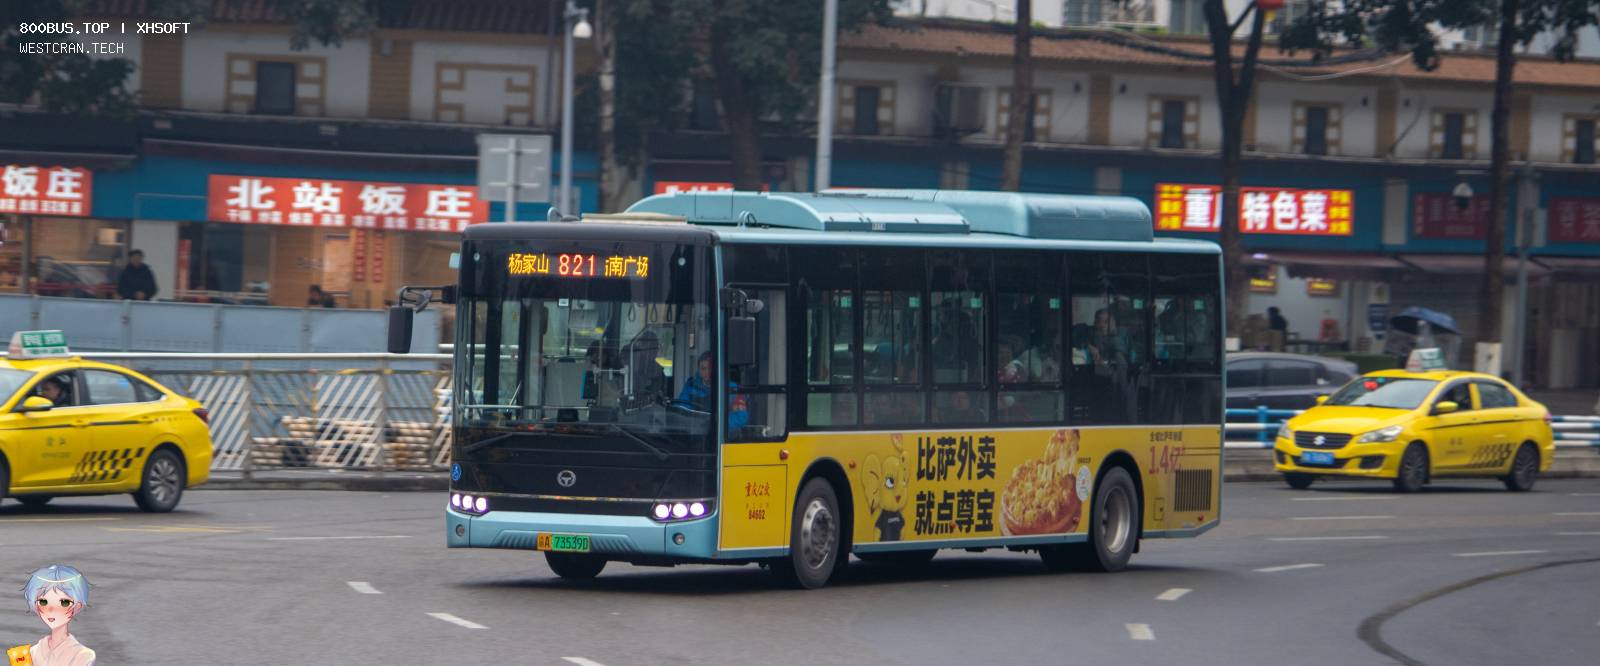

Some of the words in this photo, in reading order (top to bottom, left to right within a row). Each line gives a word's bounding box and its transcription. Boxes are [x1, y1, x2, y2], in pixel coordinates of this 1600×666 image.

[2, 165, 83, 198] 饭庄
[226, 178, 474, 218] 北站饭庄
[508, 253, 549, 275] 杨家山
[558, 254, 595, 276] 821
[916, 435, 996, 481] 比萨外卖
[914, 488, 995, 535] 就点尊宝
